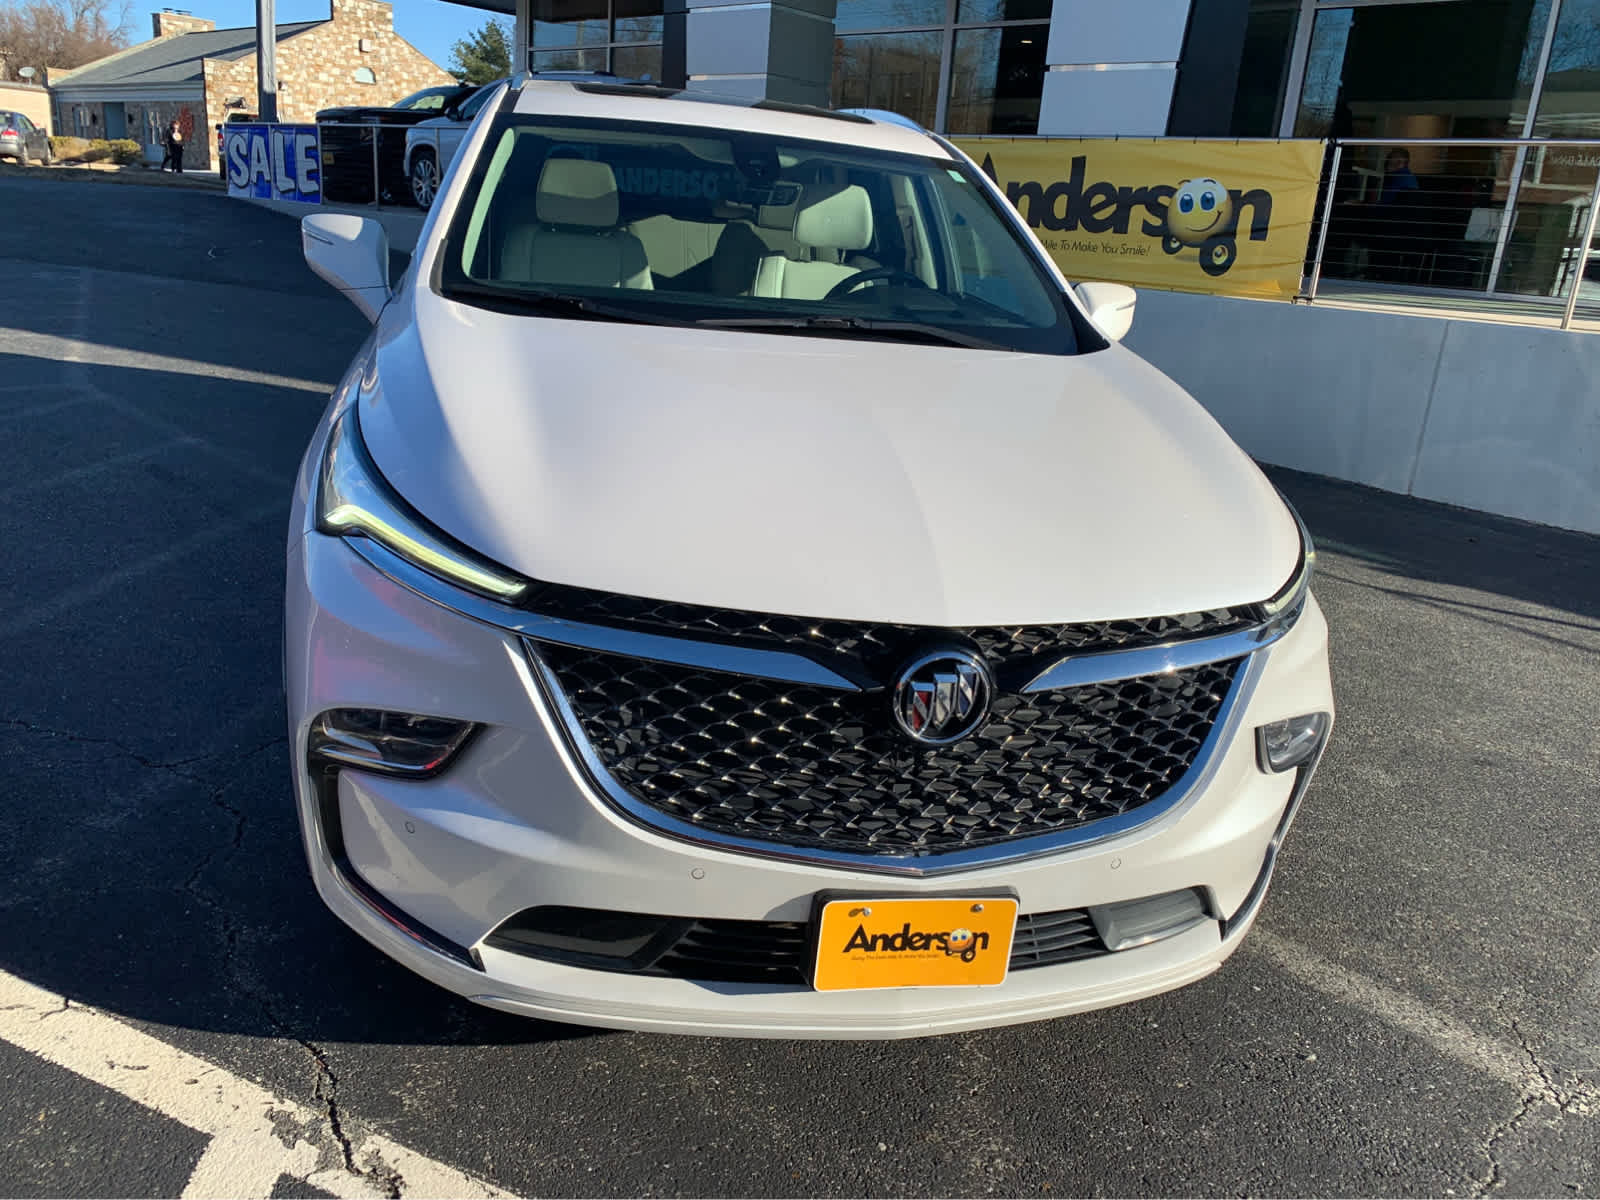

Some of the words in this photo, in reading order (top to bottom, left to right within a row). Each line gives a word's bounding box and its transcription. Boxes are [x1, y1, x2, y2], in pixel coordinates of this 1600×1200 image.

[228, 131, 320, 193] SALE
[1060, 239, 1071, 251] To
[1071, 240, 1098, 253] Make
[1101, 241, 1118, 254] You
[1120, 243, 1152, 257] Smile!
[842, 922, 990, 955] Anderson
